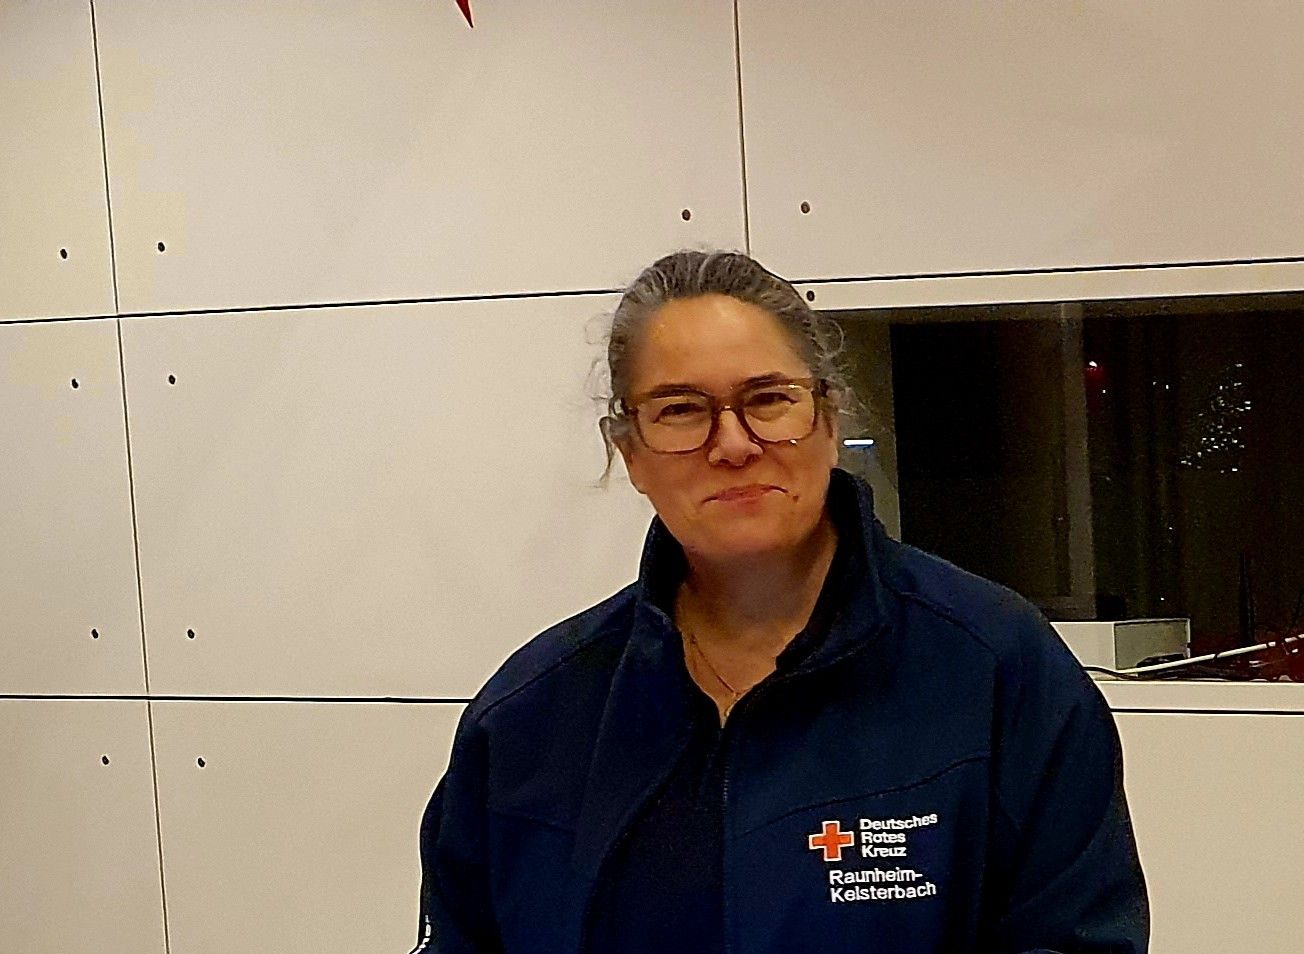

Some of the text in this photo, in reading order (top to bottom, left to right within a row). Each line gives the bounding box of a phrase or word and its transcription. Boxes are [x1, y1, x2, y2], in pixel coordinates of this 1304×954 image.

[859, 813, 938, 830] Deutsches
[860, 831, 906, 844] Rotes
[861, 845, 907, 858] Kreuz
[829, 867, 923, 885] Raunheim-
[830, 882, 937, 903] Kelsterbach
